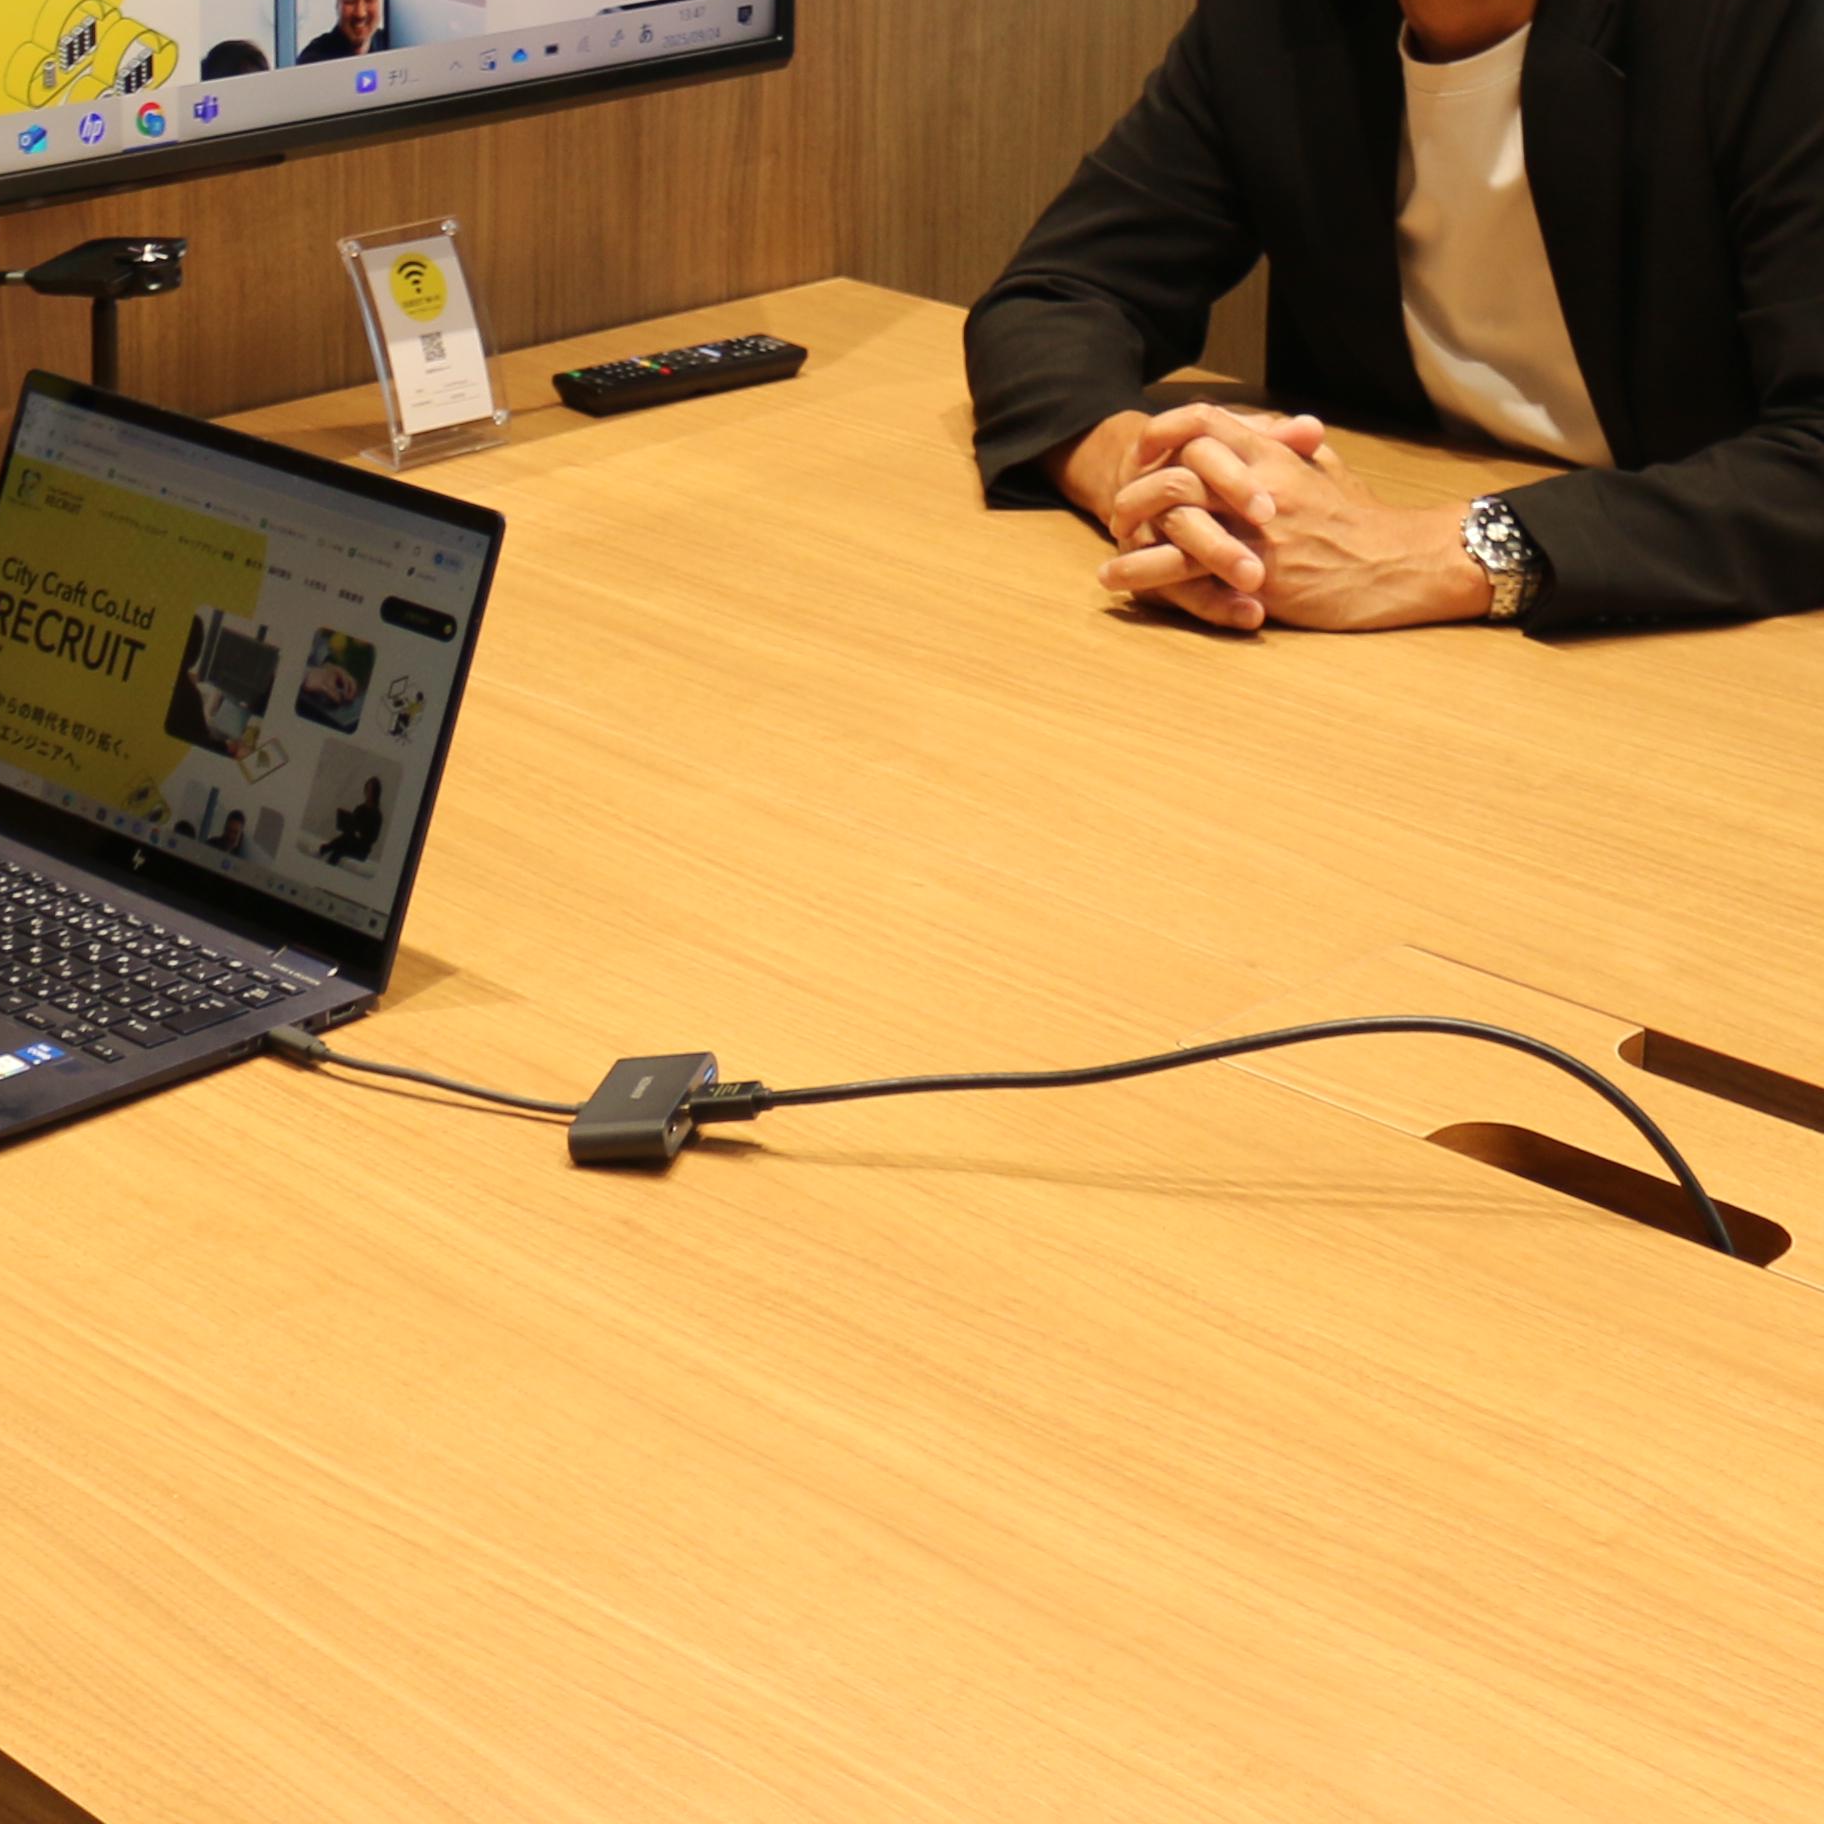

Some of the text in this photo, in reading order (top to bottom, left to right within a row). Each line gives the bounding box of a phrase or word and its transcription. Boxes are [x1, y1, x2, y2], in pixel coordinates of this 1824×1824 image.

[2, 556, 156, 630] City Craft Co.Ltd
